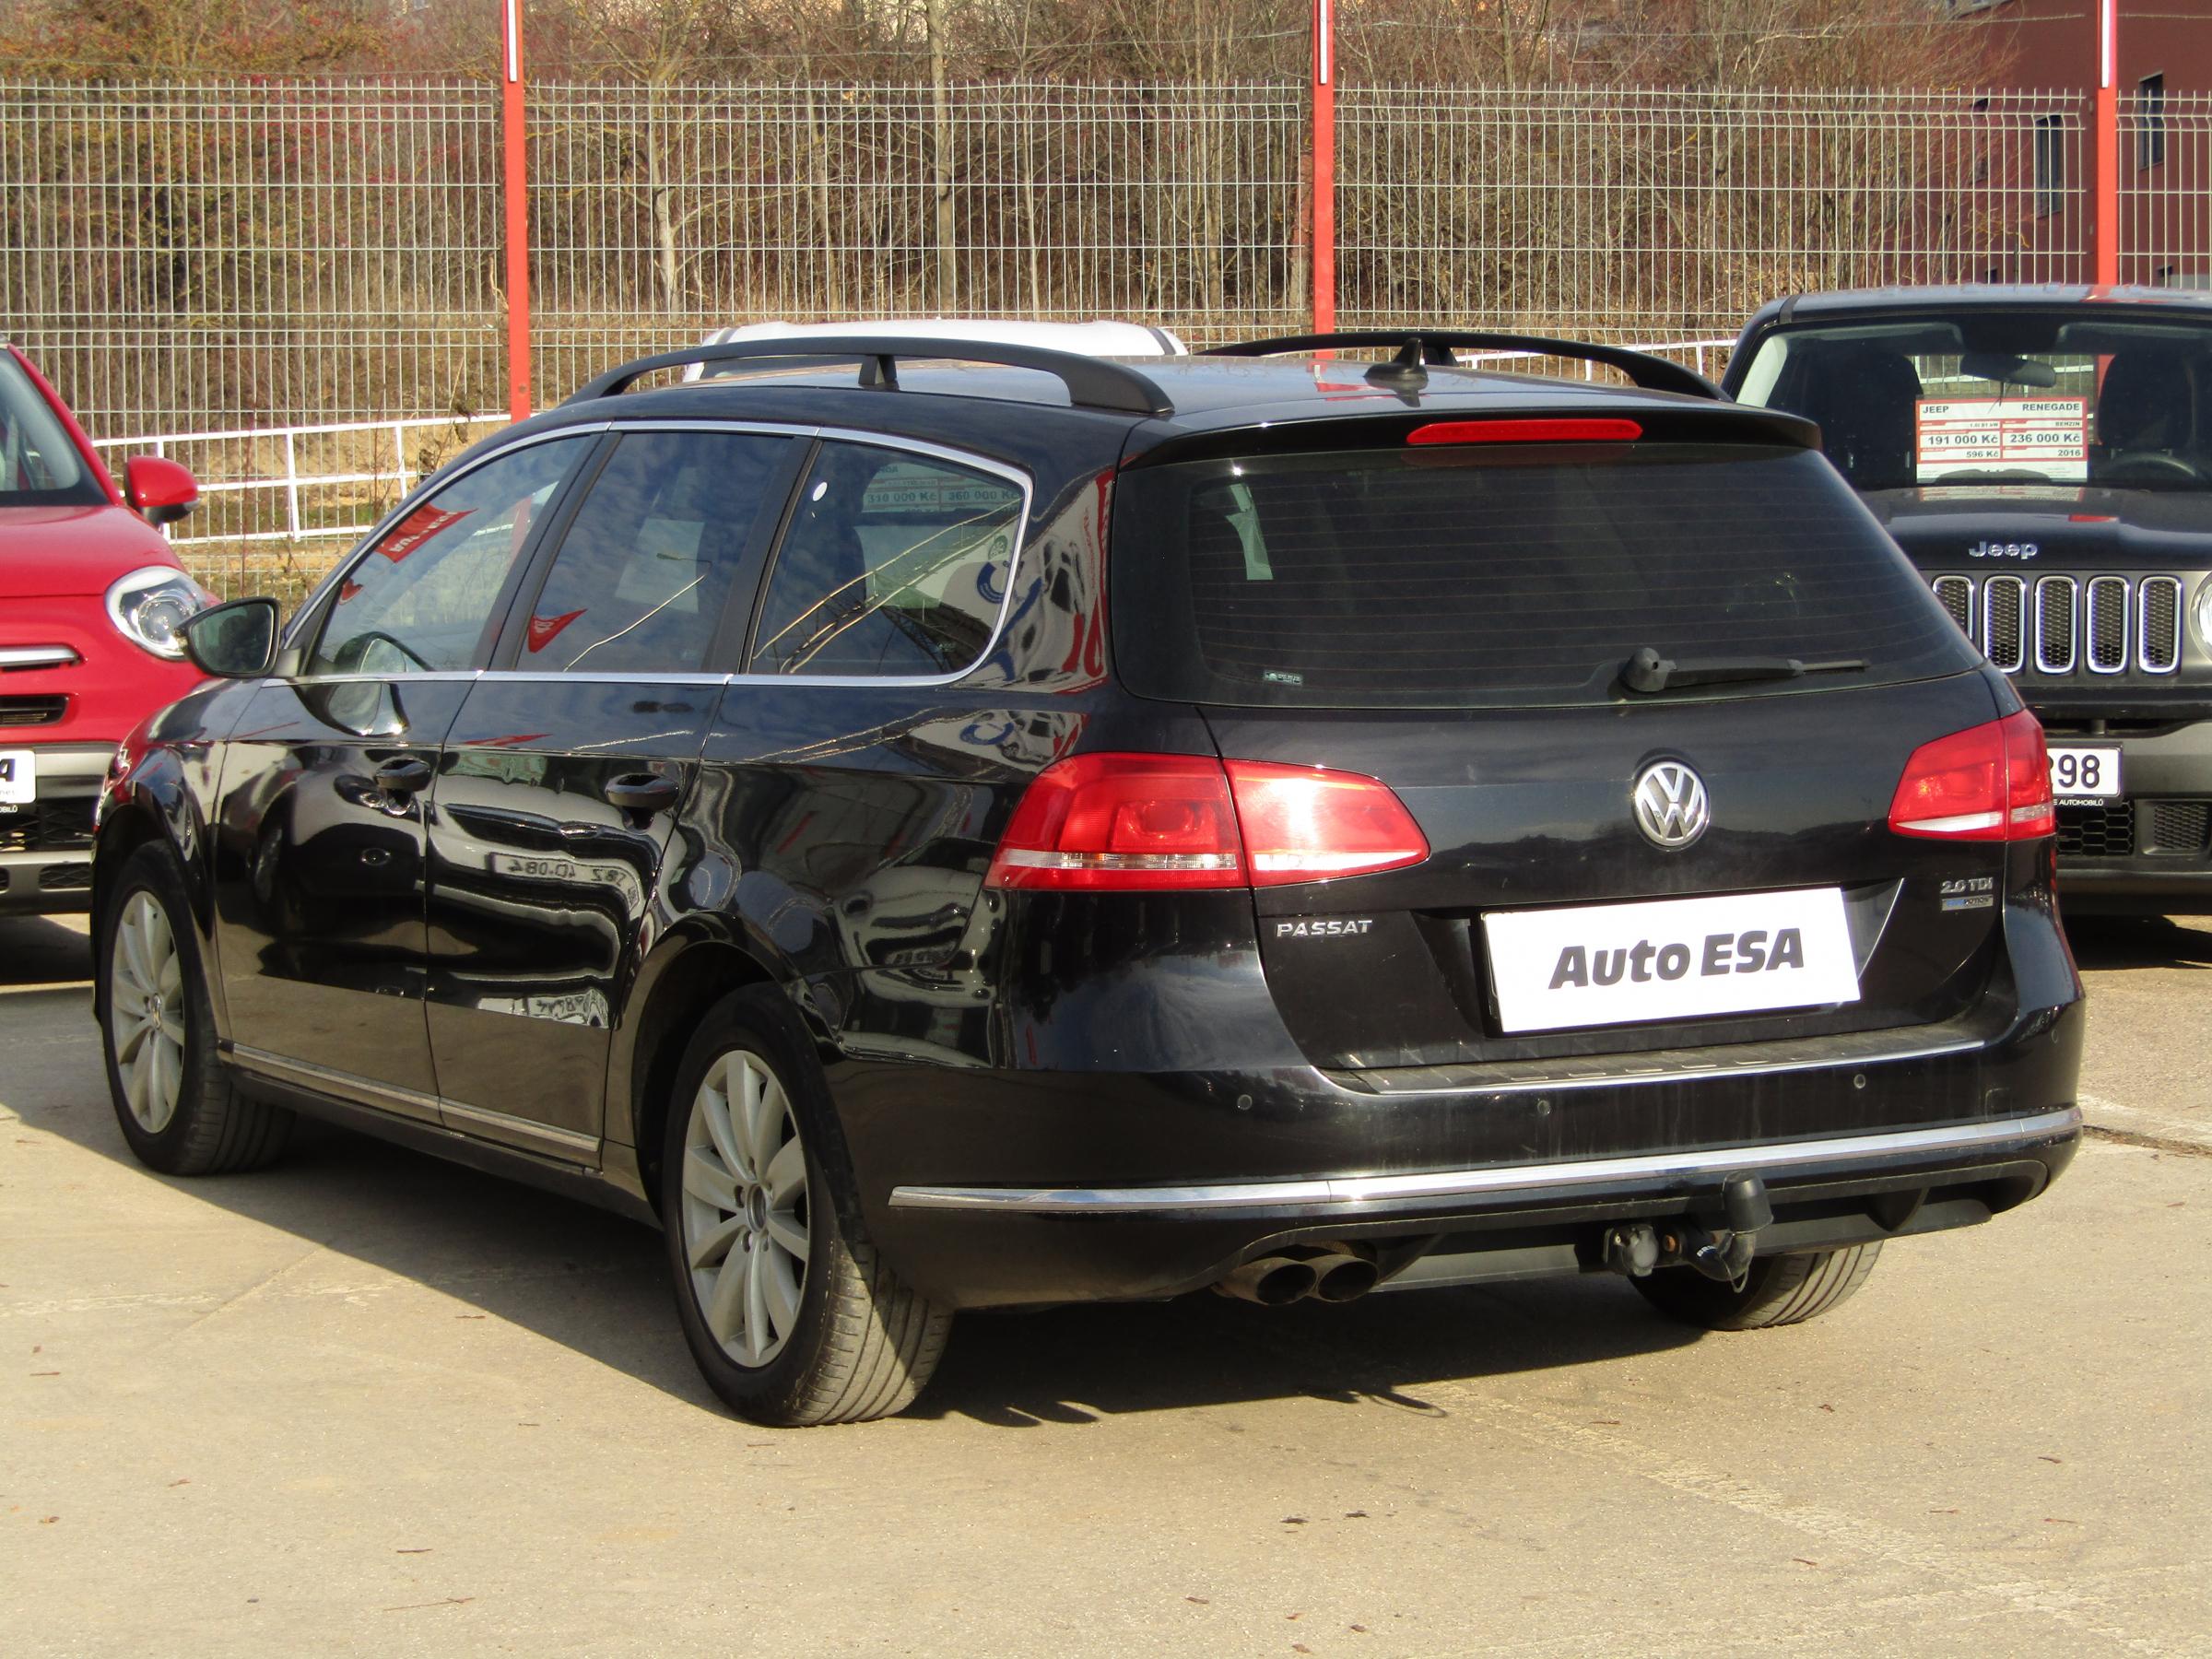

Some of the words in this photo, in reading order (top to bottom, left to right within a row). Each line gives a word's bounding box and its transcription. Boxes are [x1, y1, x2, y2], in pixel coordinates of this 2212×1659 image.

[1923, 406, 1949, 414] JEEP
[2022, 403, 2080, 411] RENEGADE
[1928, 435, 1949, 445] 191
[1954, 435, 1978, 444] 000
[1982, 434, 1998, 444] Kč
[2010, 434, 2032, 443] 236
[2036, 433, 2060, 442] 000
[2064, 433, 2080, 442] Kč
[1966, 450, 1983, 458] 596
[1986, 449, 1999, 457] Kč
[2058, 449, 2081, 457] 2016
[1969, 541, 2038, 559] Jeep
[2048, 754, 2100, 789] 98
[1968, 877, 1993, 892] TDI
[1277, 920, 1372, 937] PASSAT
[1548, 940, 1690, 989] Auto
[1700, 928, 1804, 976] ESA
